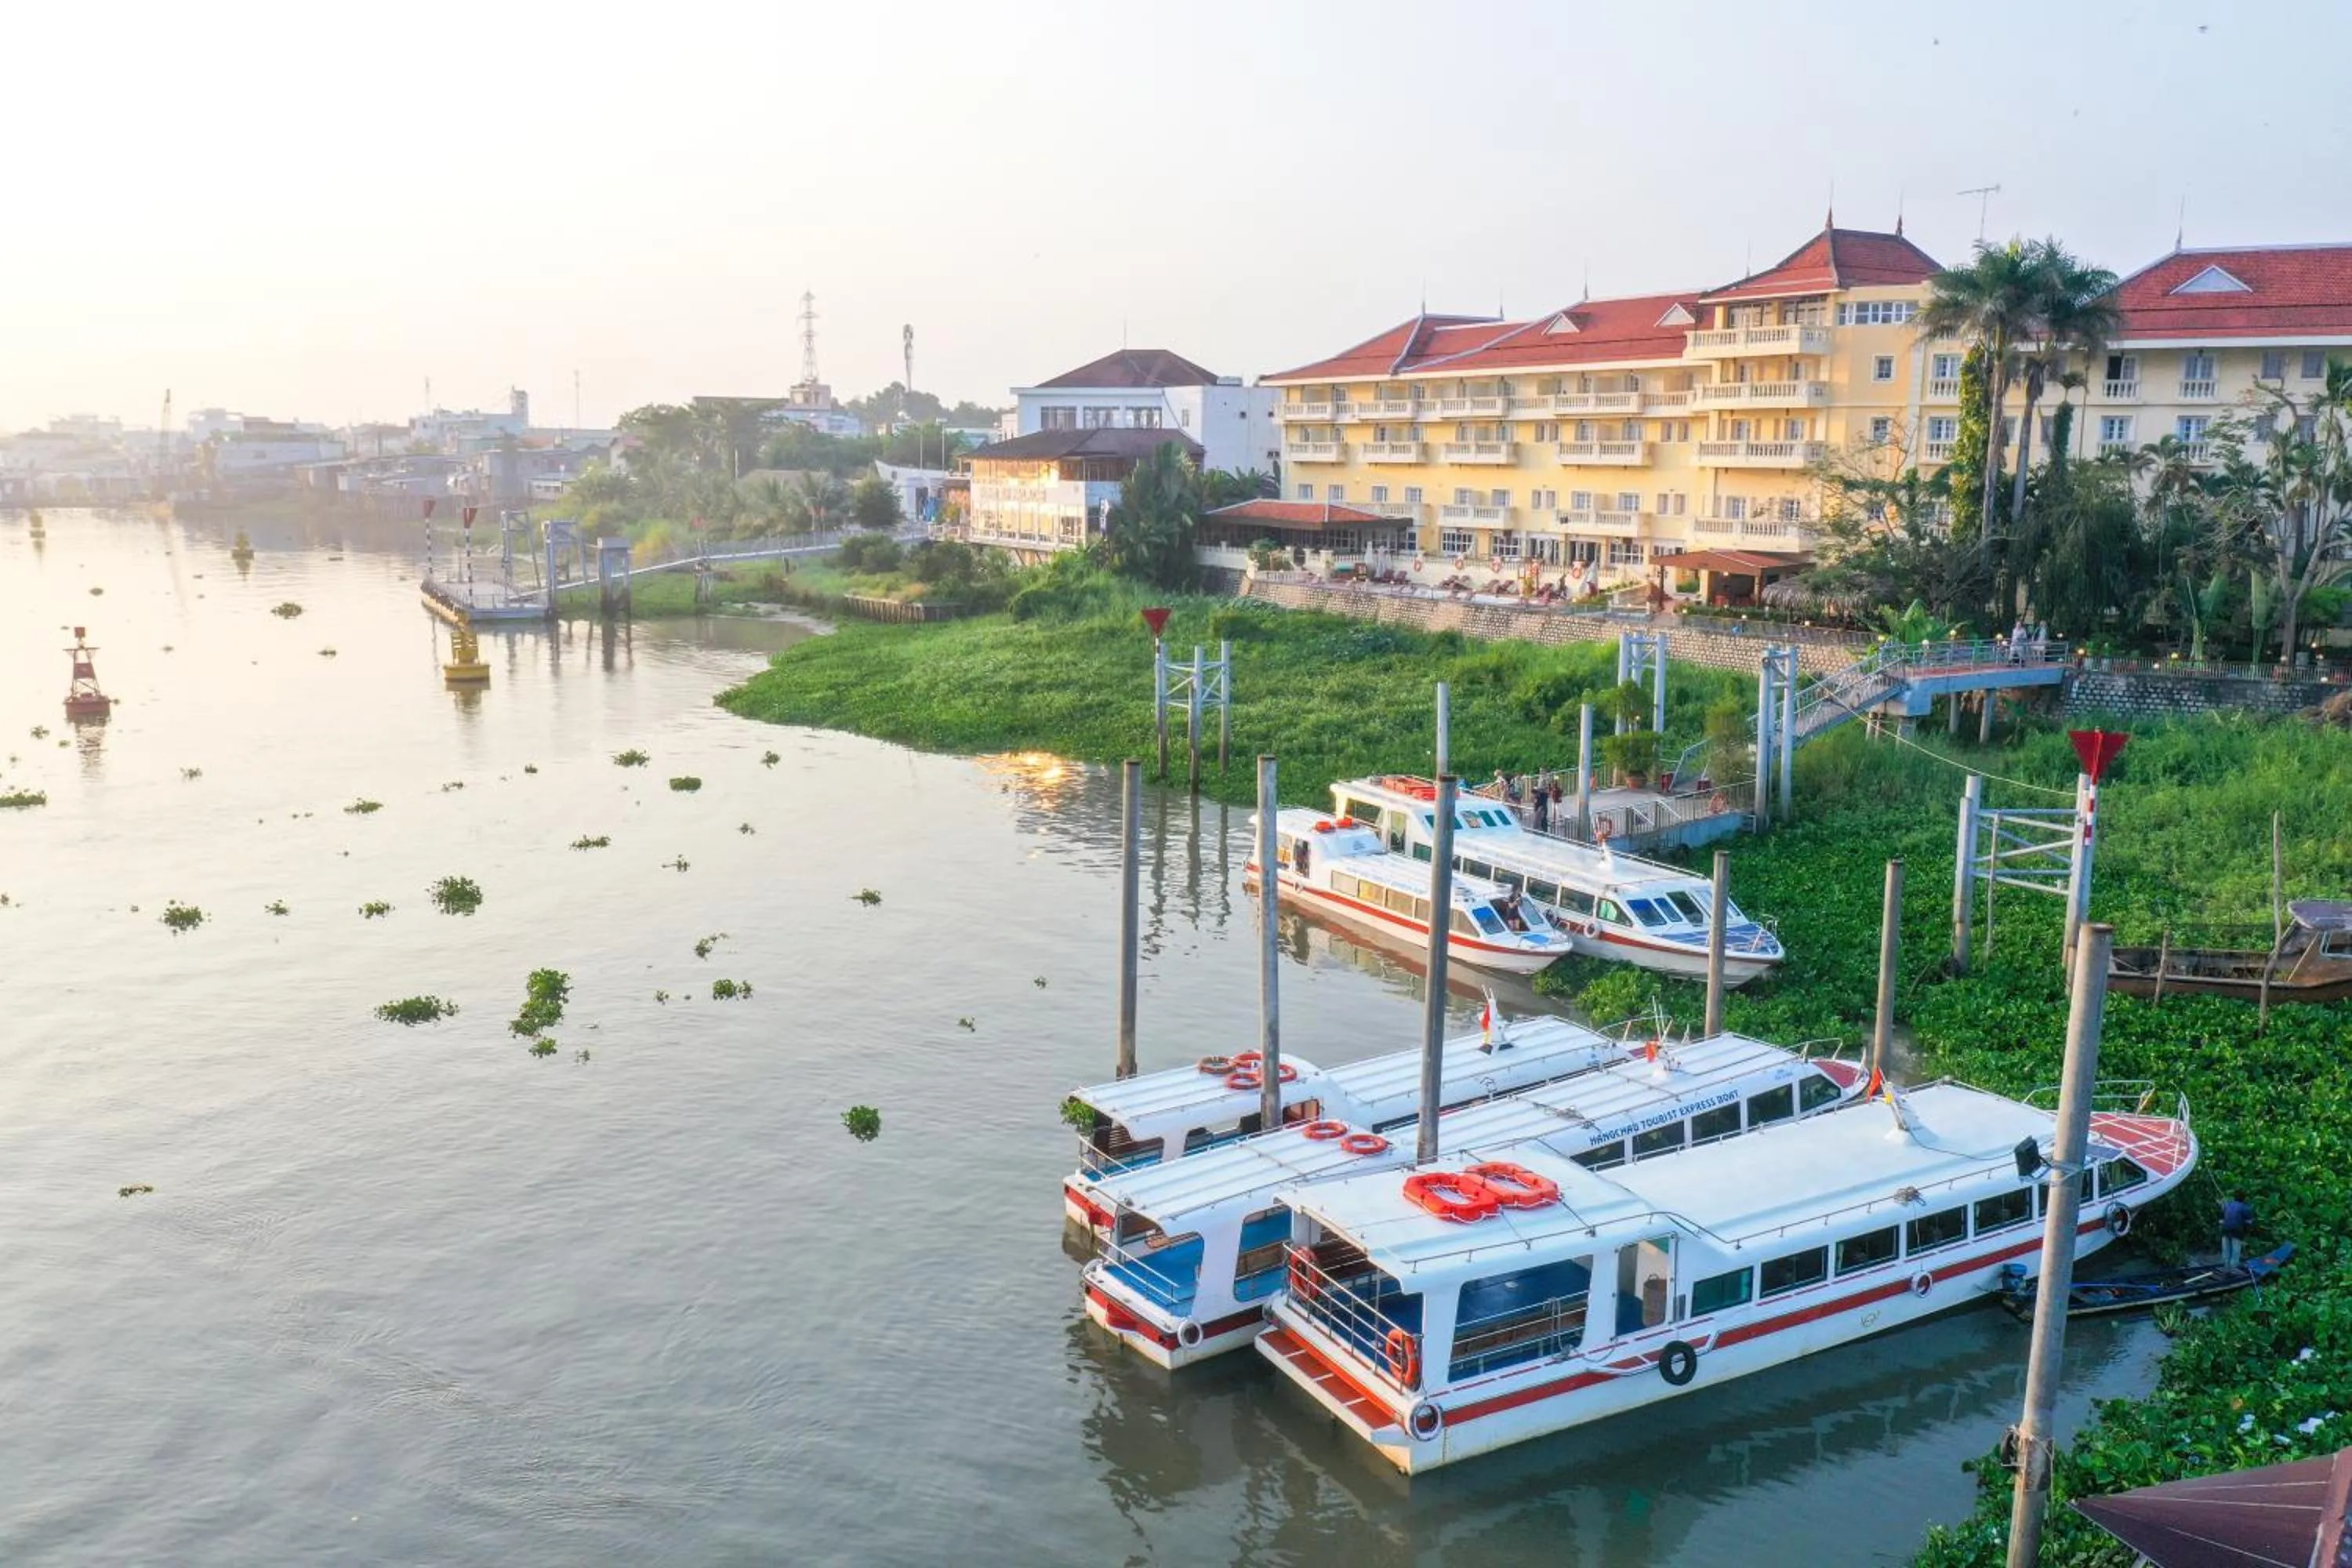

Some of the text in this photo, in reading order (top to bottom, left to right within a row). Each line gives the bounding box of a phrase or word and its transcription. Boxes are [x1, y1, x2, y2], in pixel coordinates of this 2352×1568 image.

[1640, 1109, 1677, 1129] TOURIST
[1679, 1098, 1715, 1116] EXPRESS
[1715, 1090, 1738, 1104] BOAT
